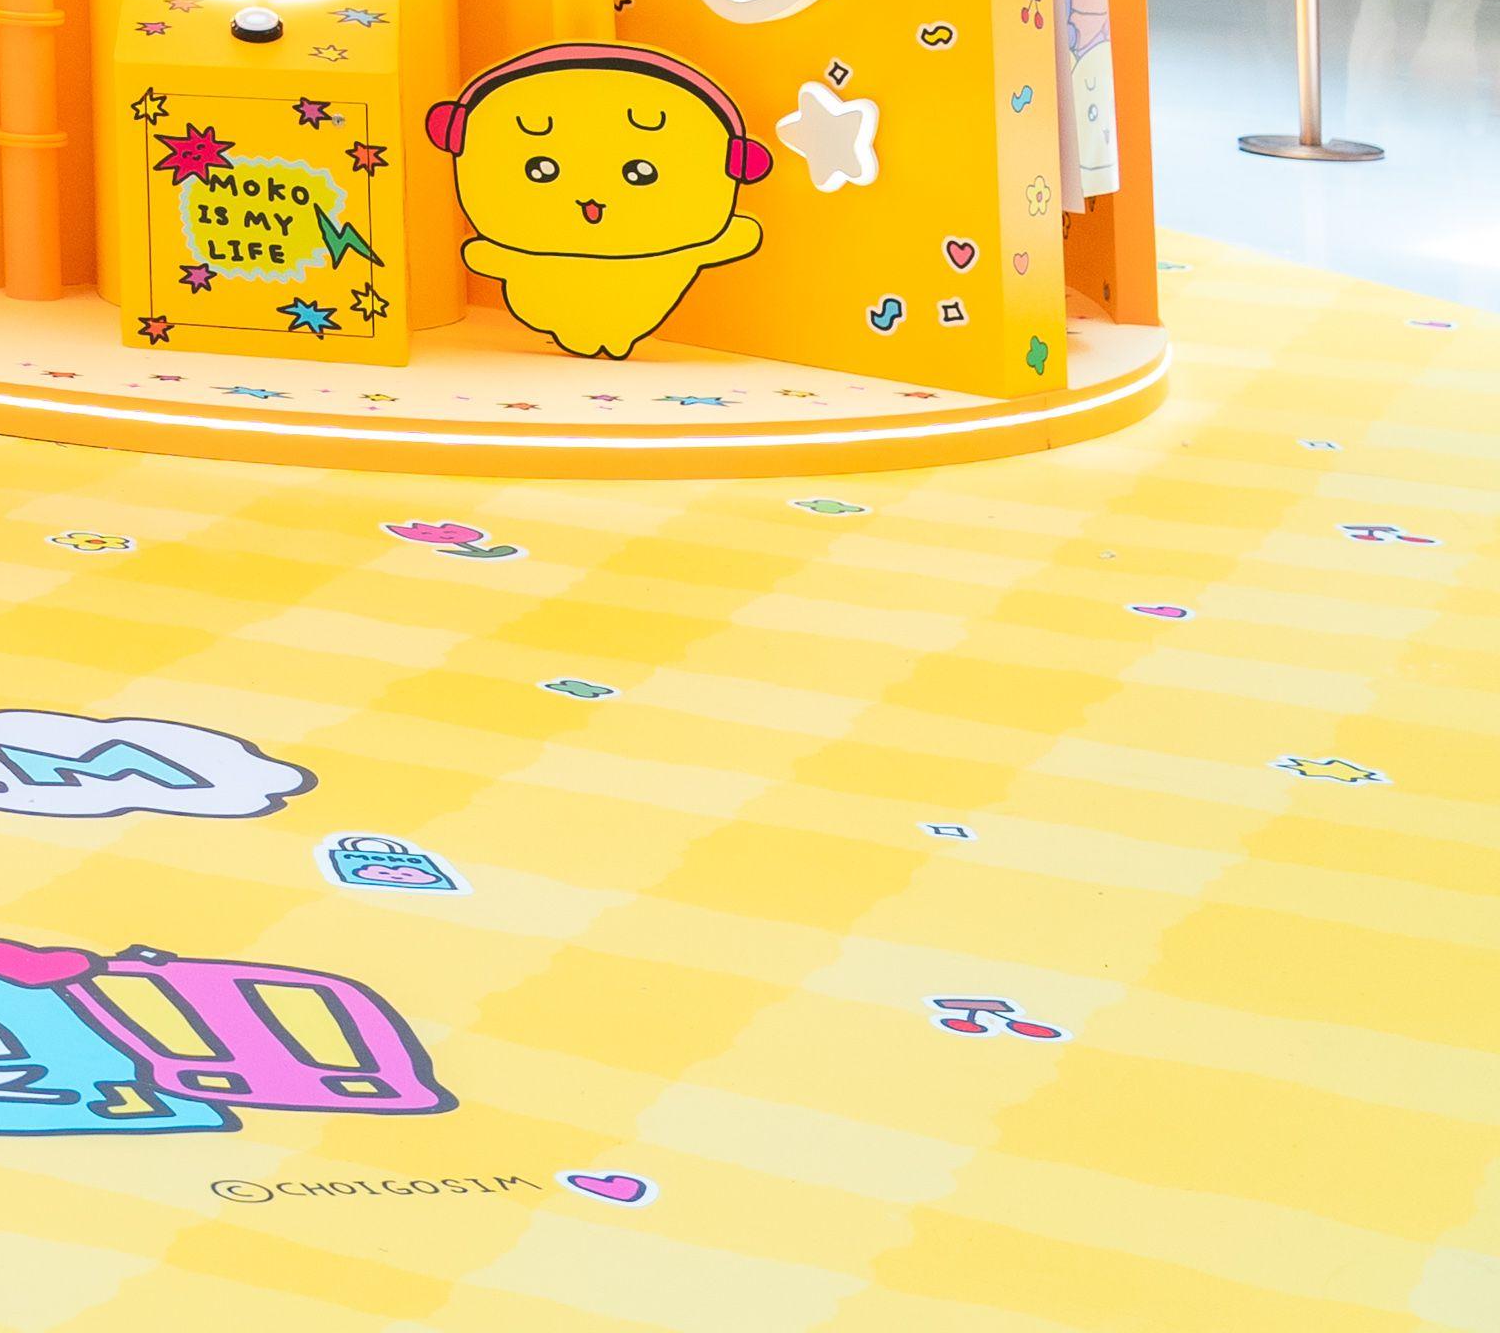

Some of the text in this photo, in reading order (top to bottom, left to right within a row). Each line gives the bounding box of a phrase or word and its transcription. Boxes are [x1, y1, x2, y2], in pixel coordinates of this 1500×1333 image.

[197, 204, 294, 237] IS MY
[207, 238, 286, 264] LIFE
